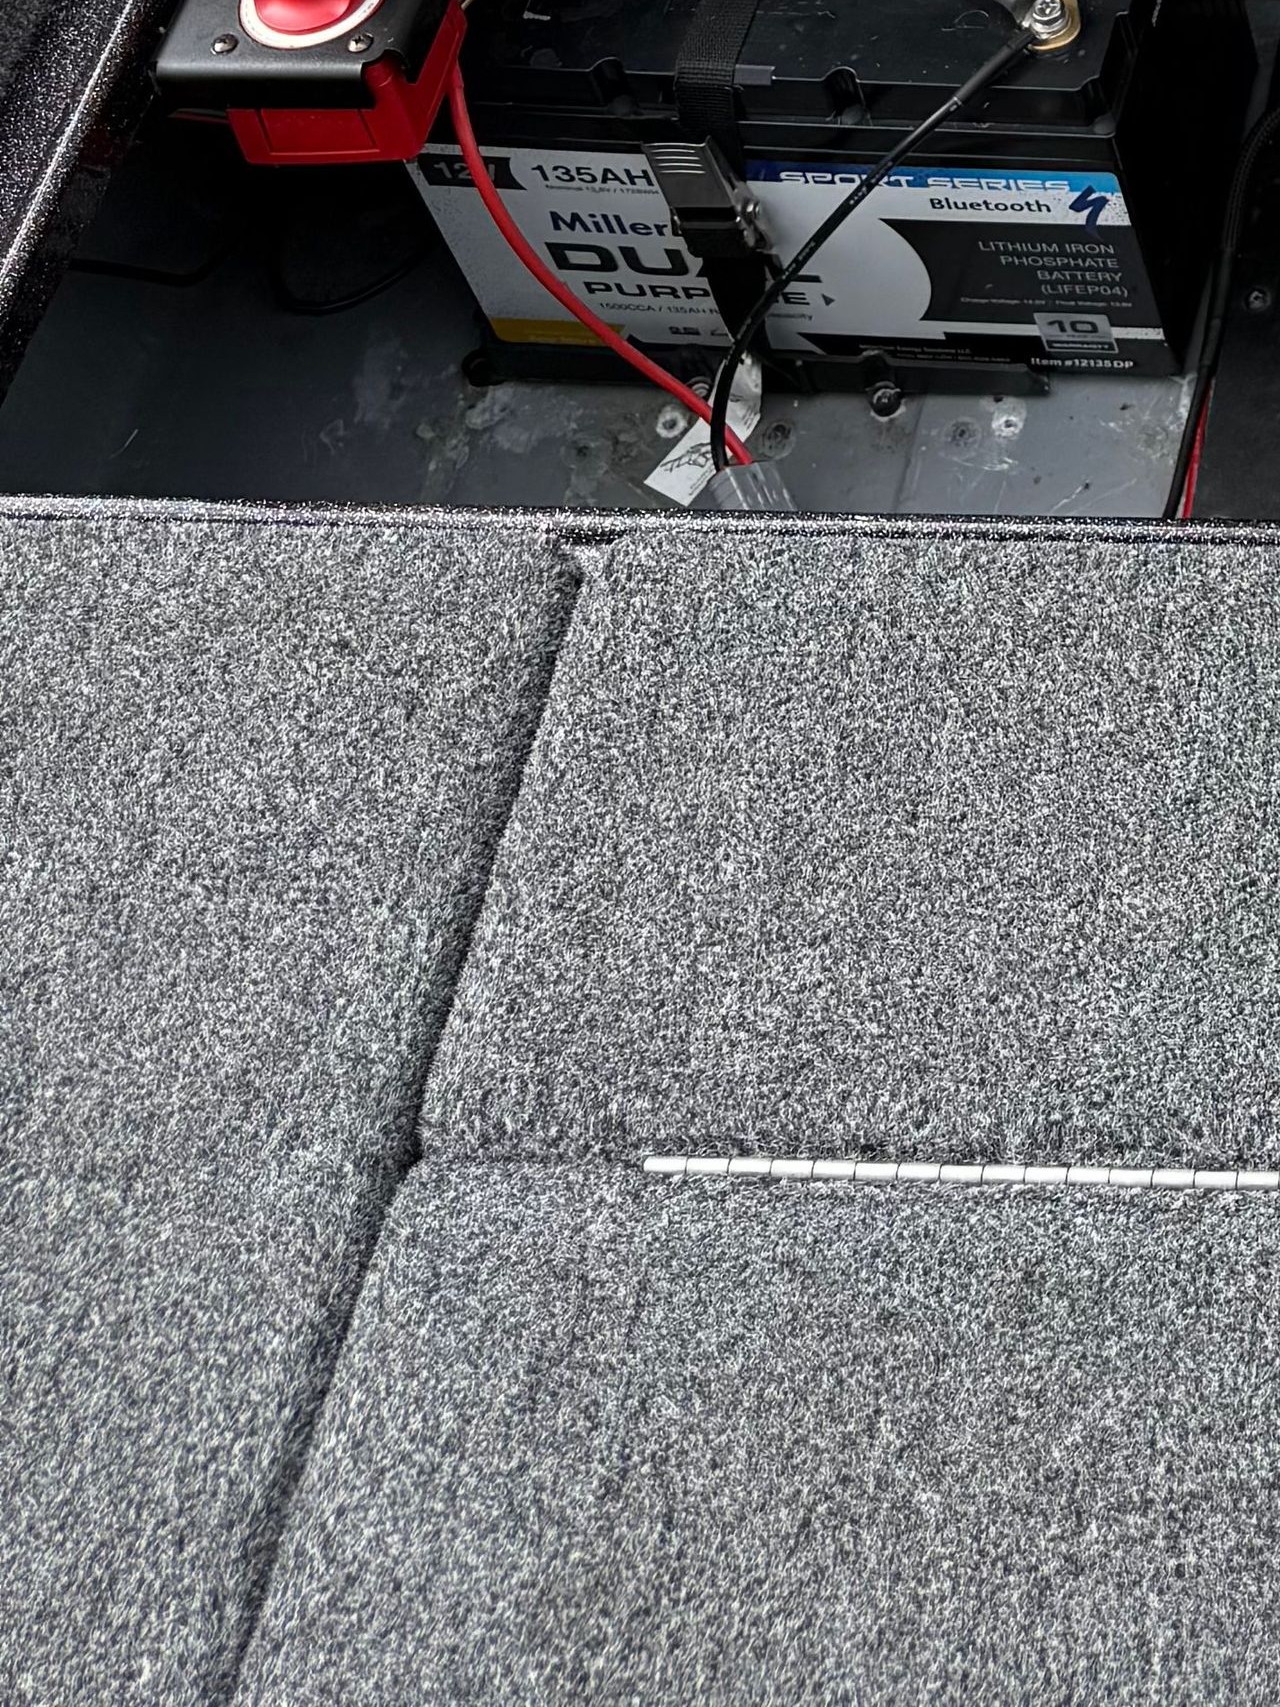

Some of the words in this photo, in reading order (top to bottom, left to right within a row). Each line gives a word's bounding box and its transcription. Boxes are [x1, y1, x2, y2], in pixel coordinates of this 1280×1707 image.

[531, 164, 656, 187] 135AH
[927, 177, 1070, 192] SERIES
[929, 198, 1051, 213] Bluetooth
[549, 210, 675, 237] Miller
[978, 241, 1060, 254] LITHIUM
[1065, 243, 1115, 255] IRON
[1000, 256, 1119, 268] PHOSPHATE
[1036, 269, 1123, 283] BATTERY
[1046, 320, 1099, 335] 10
[1031, 357, 1062, 367] Item
